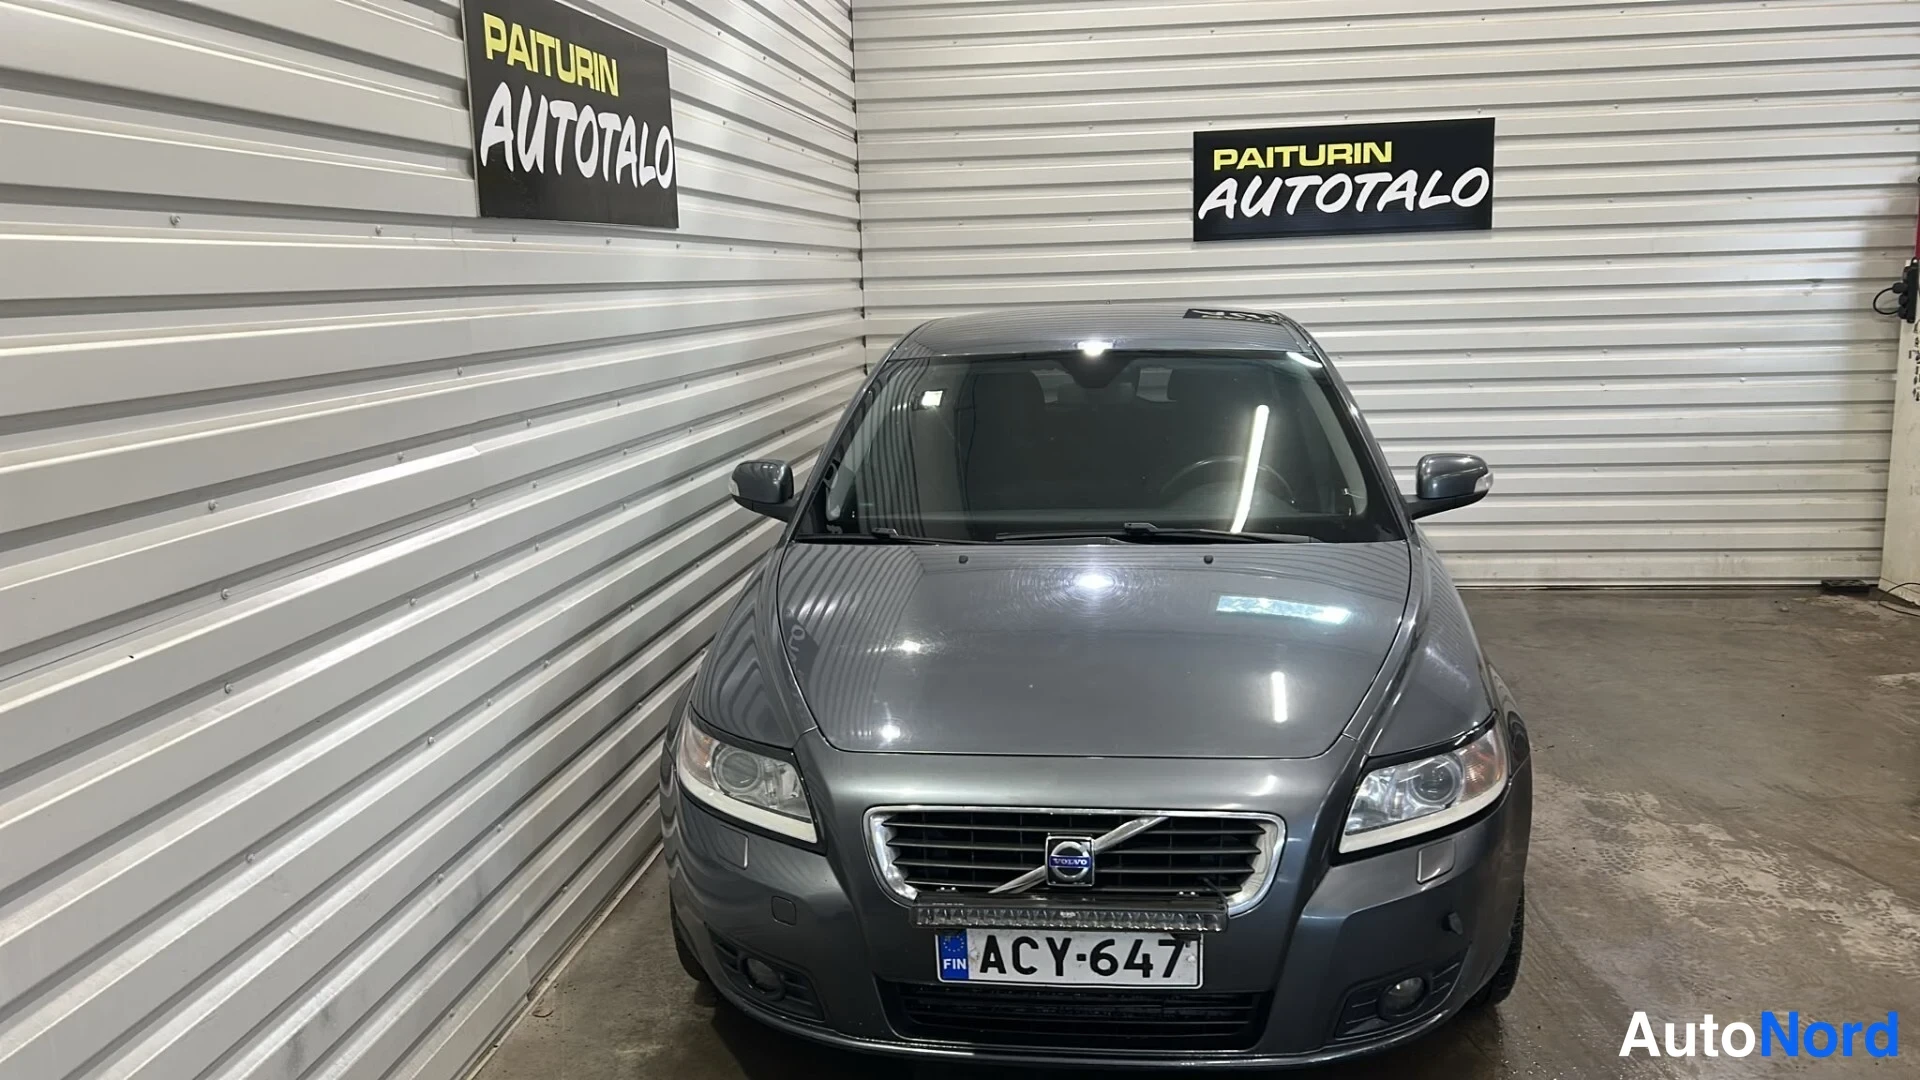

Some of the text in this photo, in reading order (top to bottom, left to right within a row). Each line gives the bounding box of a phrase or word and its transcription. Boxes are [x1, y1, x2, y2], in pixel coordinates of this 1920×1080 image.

[483, 12, 619, 97] PAITURIN
[480, 81, 674, 189] AUTOTALO
[1213, 141, 1393, 171] PAITURIN
[1198, 167, 1490, 220] AUTOTALO
[1053, 858, 1088, 866] VOLVO
[943, 958, 967, 970] FIN
[979, 935, 1187, 978] ACY-647
